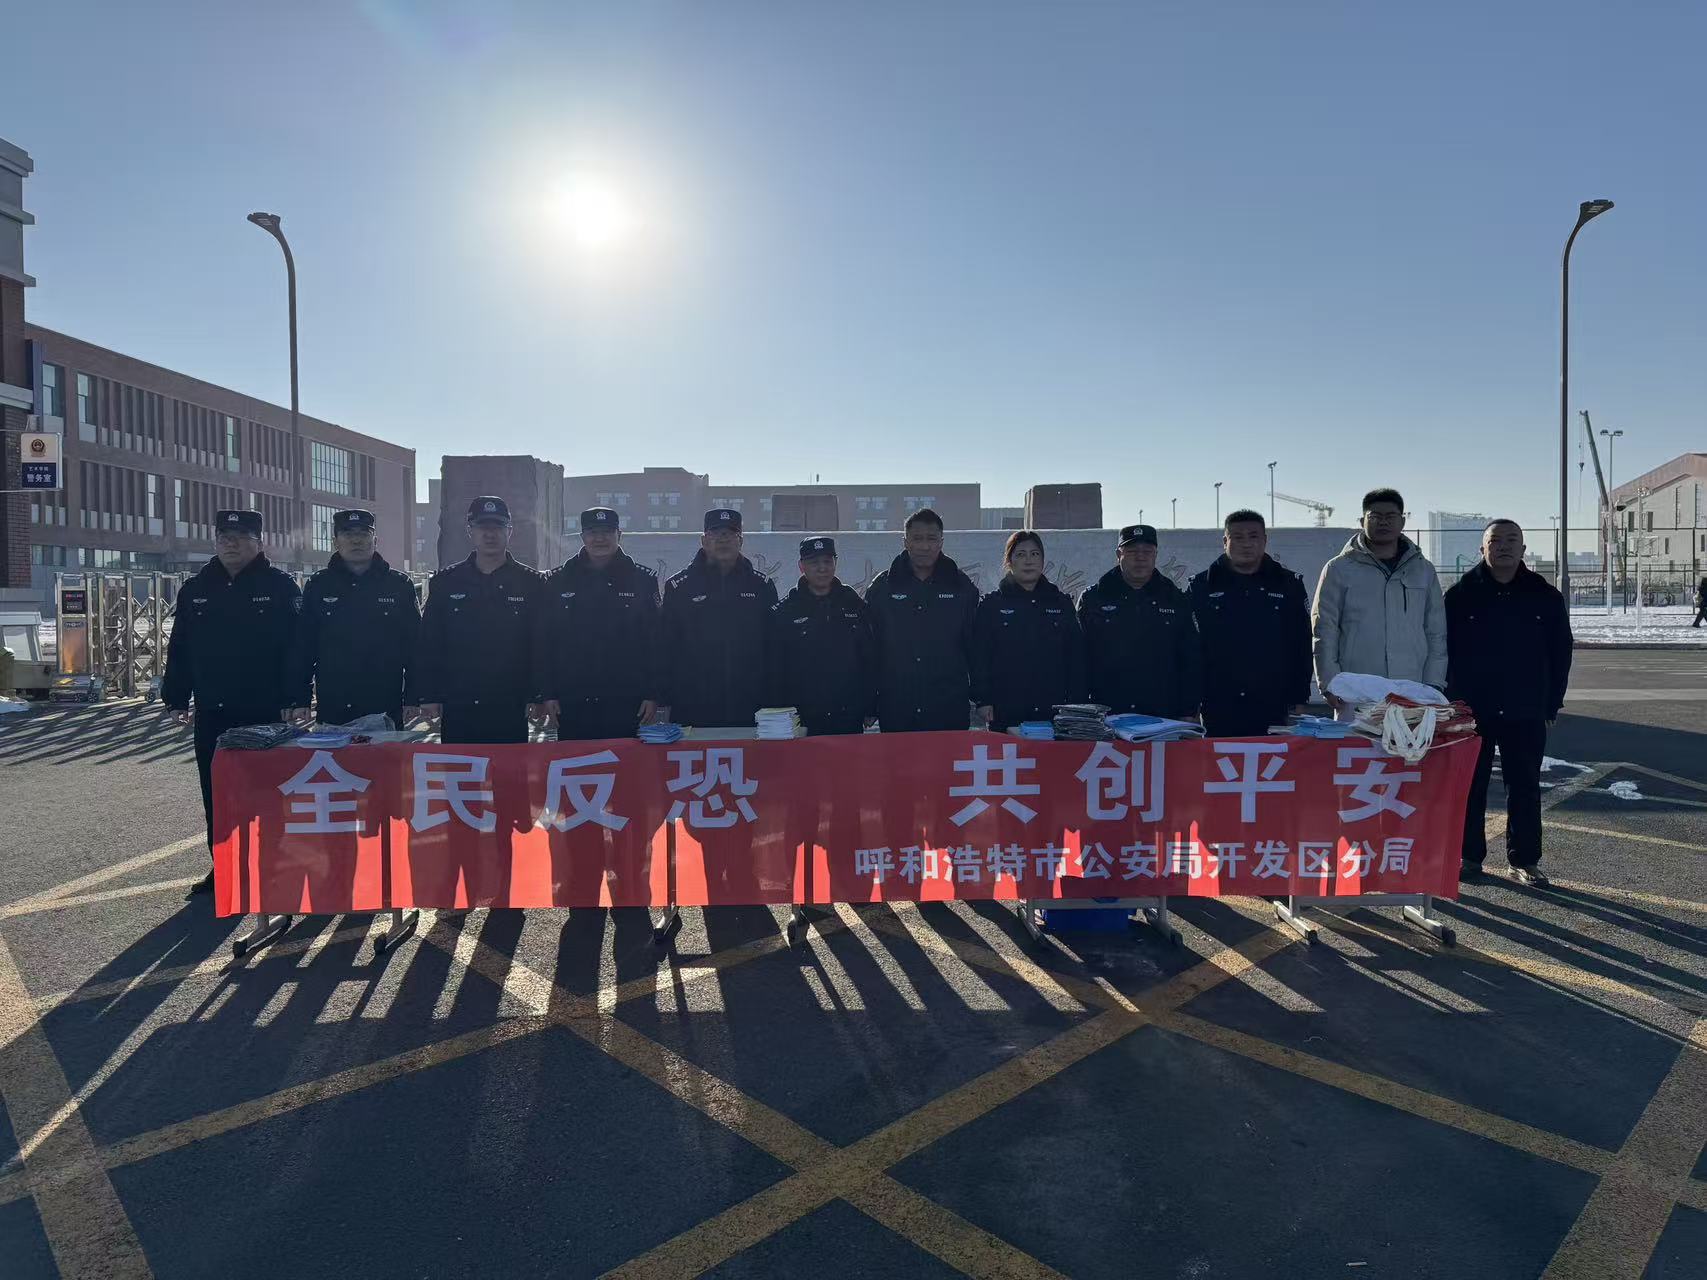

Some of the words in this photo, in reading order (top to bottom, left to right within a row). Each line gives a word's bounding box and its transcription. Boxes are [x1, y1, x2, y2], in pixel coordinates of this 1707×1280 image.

[278, 748, 758, 834] 全民反恐
[949, 741, 1422, 826] 共创平安
[854, 838, 1415, 882] 呼和浩特市公安局开发区分局
